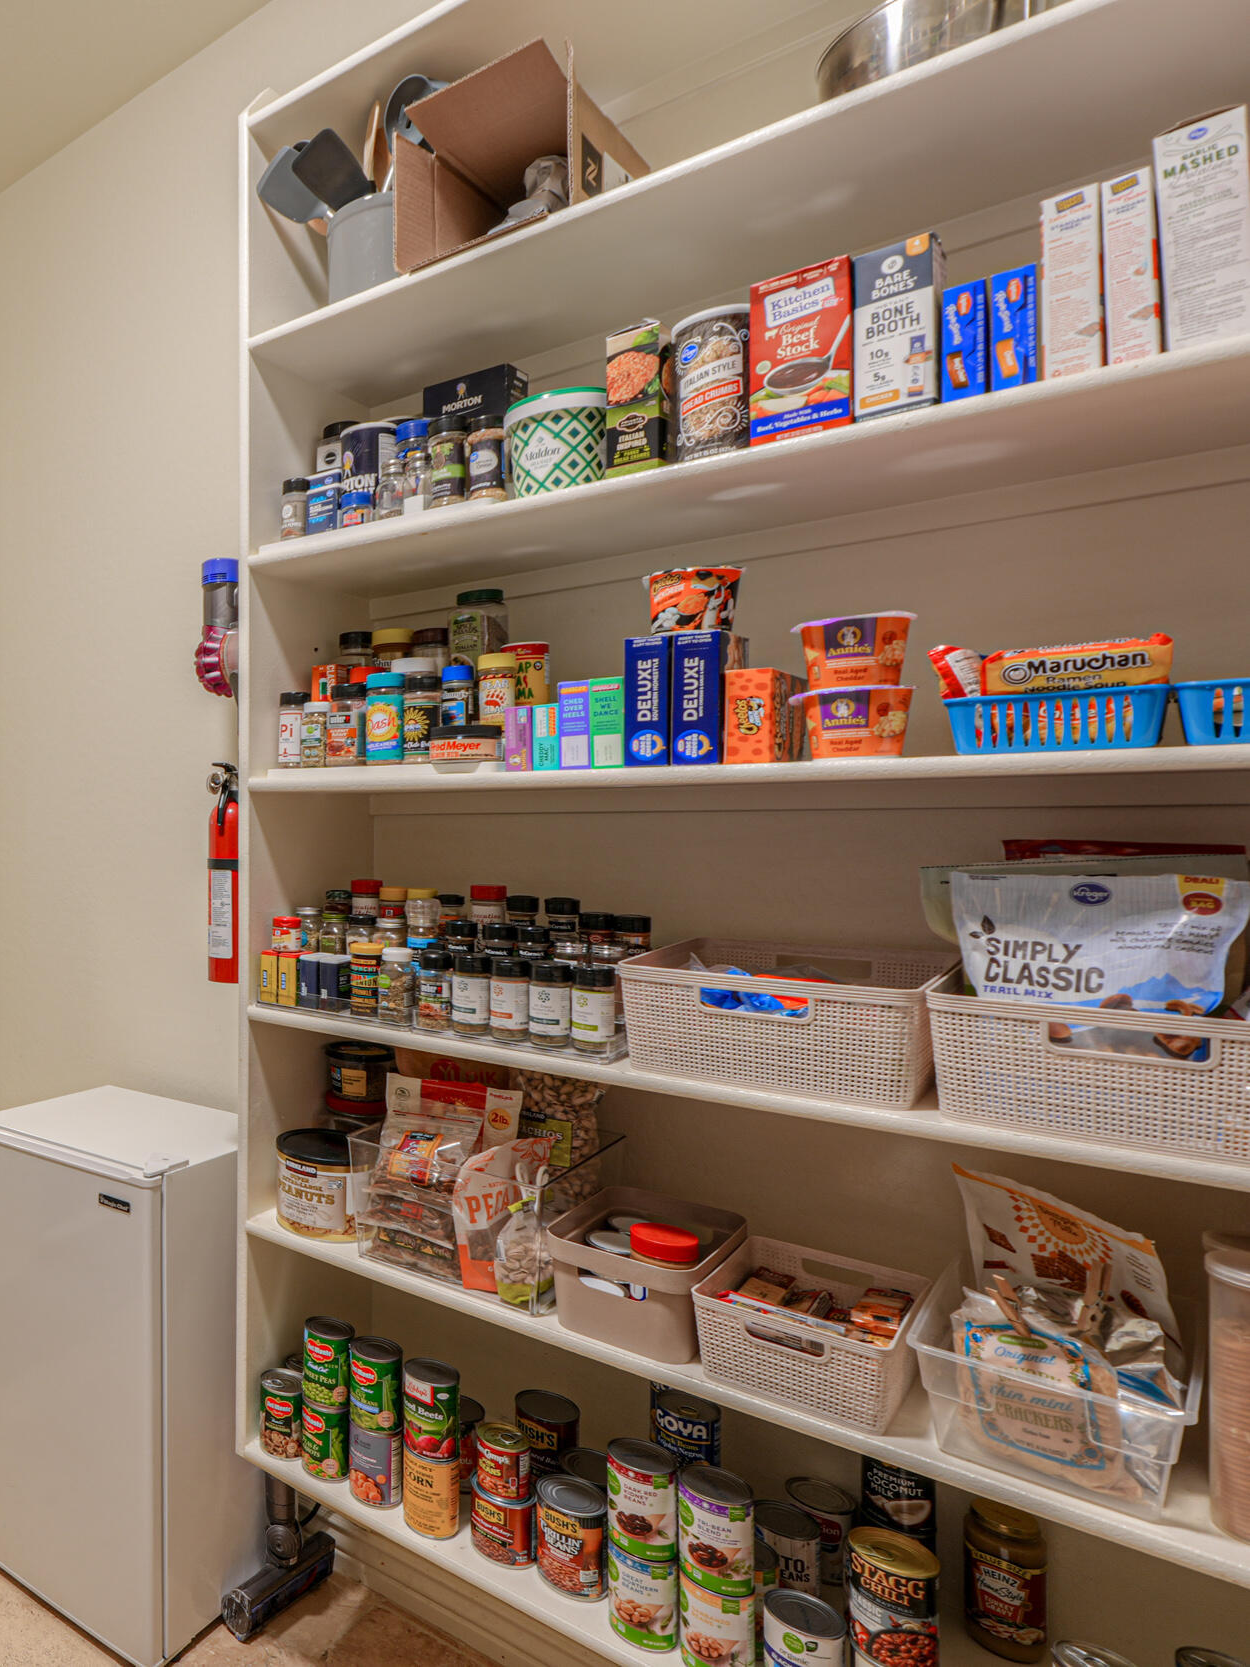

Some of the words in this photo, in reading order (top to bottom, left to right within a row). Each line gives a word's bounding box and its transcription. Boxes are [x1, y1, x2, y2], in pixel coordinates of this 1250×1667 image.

[1163, 144, 1239, 180] MASHED
[875, 269, 911, 290] BARE
[770, 283, 831, 312] Kitchen
[871, 277, 917, 301] BONES
[772, 299, 820, 322] Basics
[871, 301, 915, 326] BONE
[865, 313, 921, 340] BROTH
[781, 327, 816, 346] Beef
[777, 339, 820, 359] Stock
[870, 349, 890, 361] 10g
[684, 369, 711, 388] ITALIAN
[711, 359, 738, 376] STYLE
[873, 372, 886, 383] 5g
[442, 395, 483, 414] MORTON
[682, 394, 704, 412] BREAD
[705, 383, 739, 403] CRUMBS
[756, 422, 774, 433] Beef,
[775, 414, 811, 429] Vegetables
[820, 407, 843, 418] Herbs
[616, 437, 648, 450] INSPIRED
[618, 430, 645, 443] ITALIAN
[525, 446, 562, 463] Maldon
[827, 643, 872, 657] Annie's
[1027, 651, 1147, 675] Maruchan
[1045, 673, 1103, 685] Ramen
[637, 658, 653, 722] DELUXE
[683, 656, 700, 722] DELUXE
[563, 697, 584, 705] CHED
[594, 696, 618, 704] SHELL
[652, 690, 660, 721] SOUTHERN
[367, 711, 397, 733] Dash
[563, 711, 586, 720] HEELS
[593, 709, 619, 717] DANCE
[823, 717, 866, 728] Annie's
[446, 740, 481, 753] Meyer
[1072, 885, 1110, 901] Kroger
[986, 937, 1083, 965] SIMPLY
[983, 957, 1105, 993] CLASSIC
[982, 984, 1021, 996] TRAIL
[1023, 988, 1053, 999] MIX
[994, 1346, 1057, 1364] Original
[319, 1374, 336, 1385] PEAS
[406, 1380, 429, 1397] Libby's
[1030, 1396, 1075, 1411] mini
[417, 1407, 444, 1421] Beets
[995, 1402, 1075, 1432] CRACKERS
[517, 1418, 556, 1447] BUSH'S
[655, 1408, 708, 1440] GOYA
[405, 1467, 434, 1489] CORN
[866, 1472, 924, 1497] COCONUT
[873, 1467, 915, 1488] PREMIUM
[623, 1483, 642, 1495] DARK
[644, 1490, 658, 1498] RED
[623, 1488, 650, 1502] KIDNEY
[870, 1482, 895, 1499] MILK
[623, 1494, 647, 1507] BEANS
[476, 1500, 503, 1524] BUSH'S
[544, 1510, 578, 1534] BUSH'S
[697, 1518, 733, 1534] TRI-BEAN
[697, 1524, 722, 1538] BLEND
[540, 1519, 584, 1547] GRILLIN'
[973, 1550, 1003, 1567] VALUE
[621, 1570, 643, 1584] GREAT
[780, 1570, 811, 1583] EANS
[851, 1551, 927, 1600] STAGG
[982, 1567, 1018, 1588] HEINZ
[621, 1576, 659, 1594] NORTHERN
[621, 1582, 644, 1596] BEANS
[860, 1577, 911, 1607] CHILI
[984, 1594, 1015, 1612] TURKEY
[985, 1600, 1014, 1617] GRAVY
